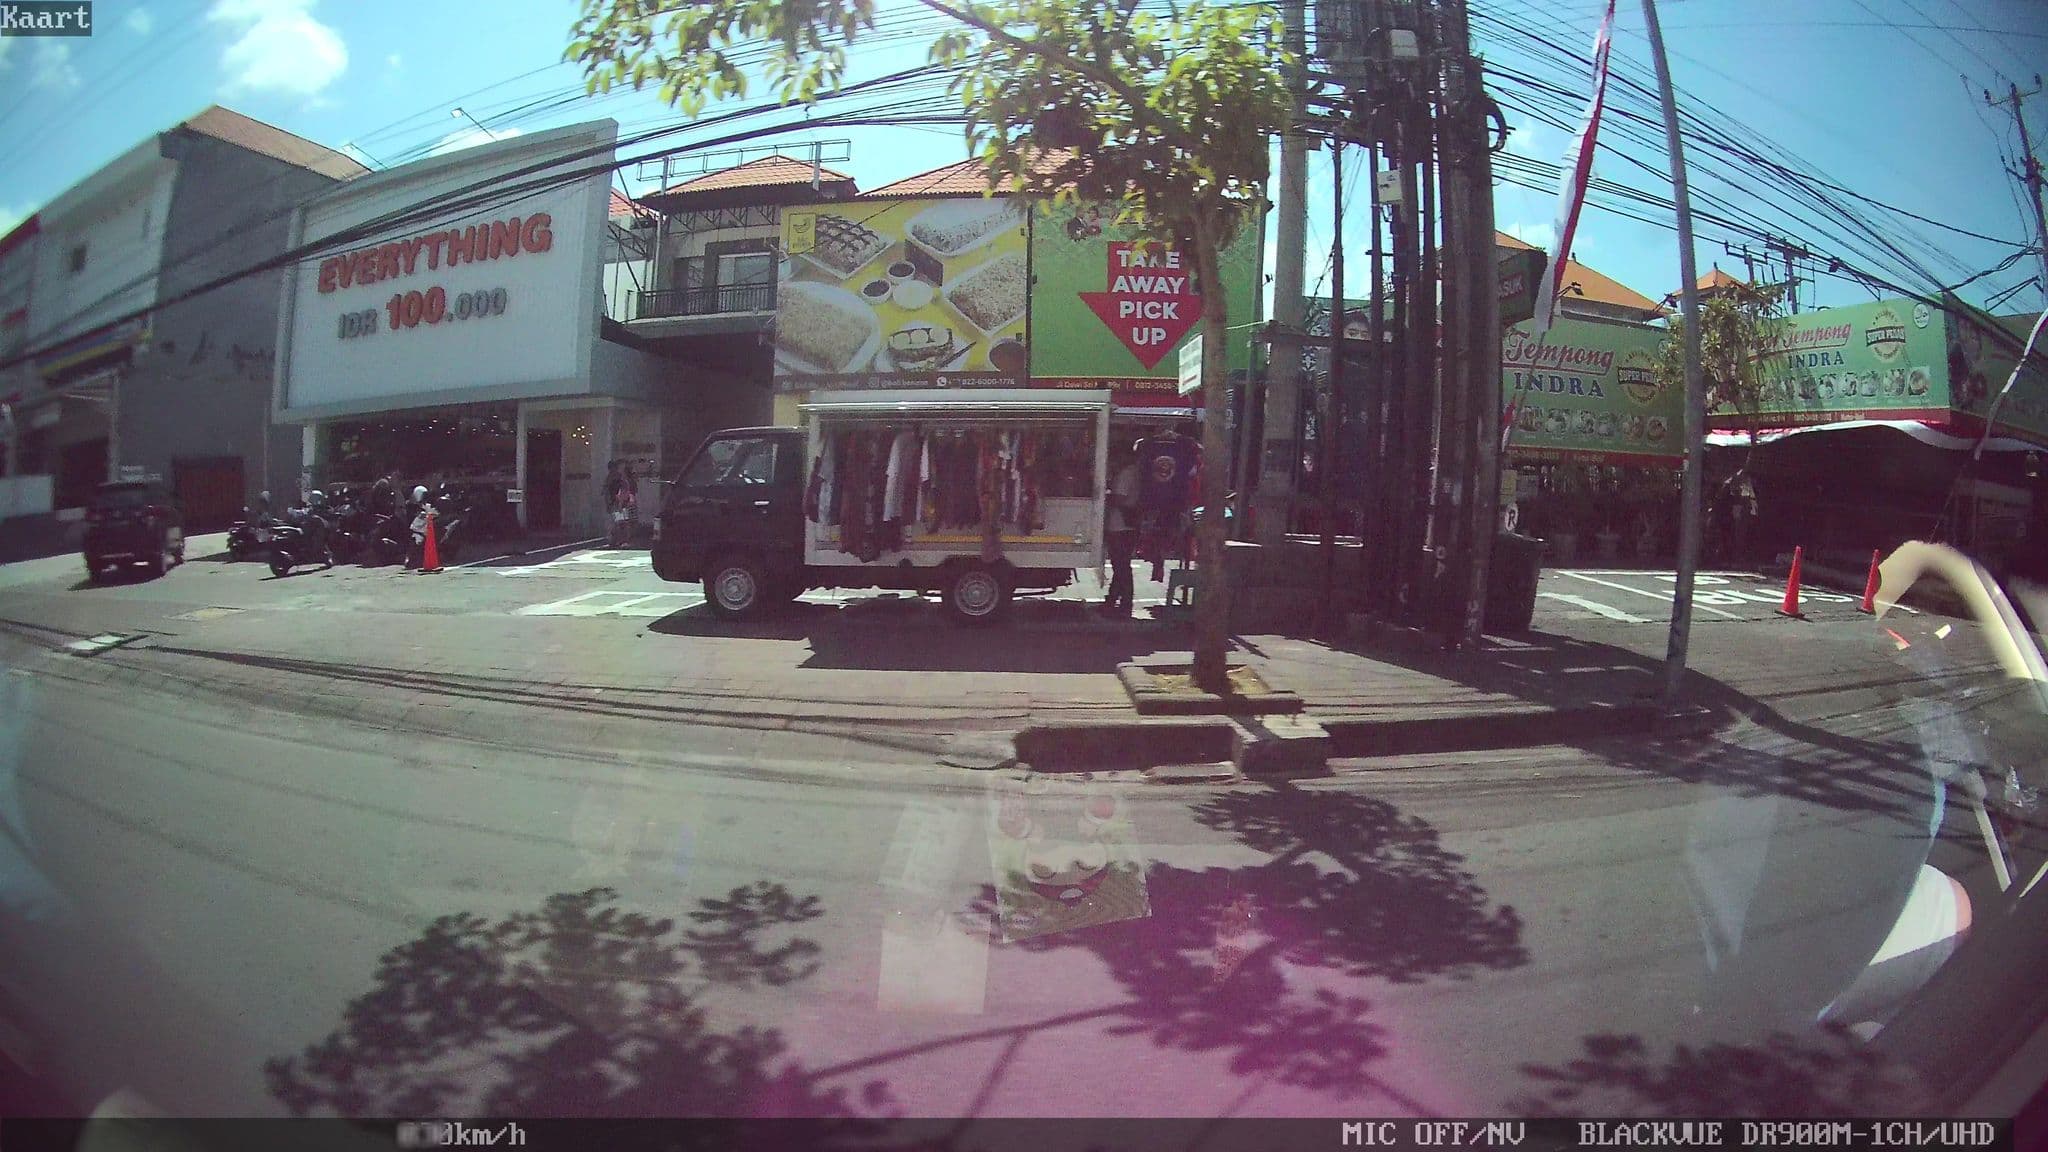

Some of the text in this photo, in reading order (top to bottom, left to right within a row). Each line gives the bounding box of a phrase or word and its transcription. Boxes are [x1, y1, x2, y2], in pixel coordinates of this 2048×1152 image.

[317, 212, 553, 294] EVERYTHING
[1111, 275, 1185, 295] AWAY
[1119, 300, 1180, 320] PICK
[337, 307, 378, 339] IDR
[1131, 326, 1167, 346] UP
[1505, 331, 1615, 377] Tempong
[1788, 350, 1845, 370] INDRA
[1513, 372, 1604, 399] INDRA
